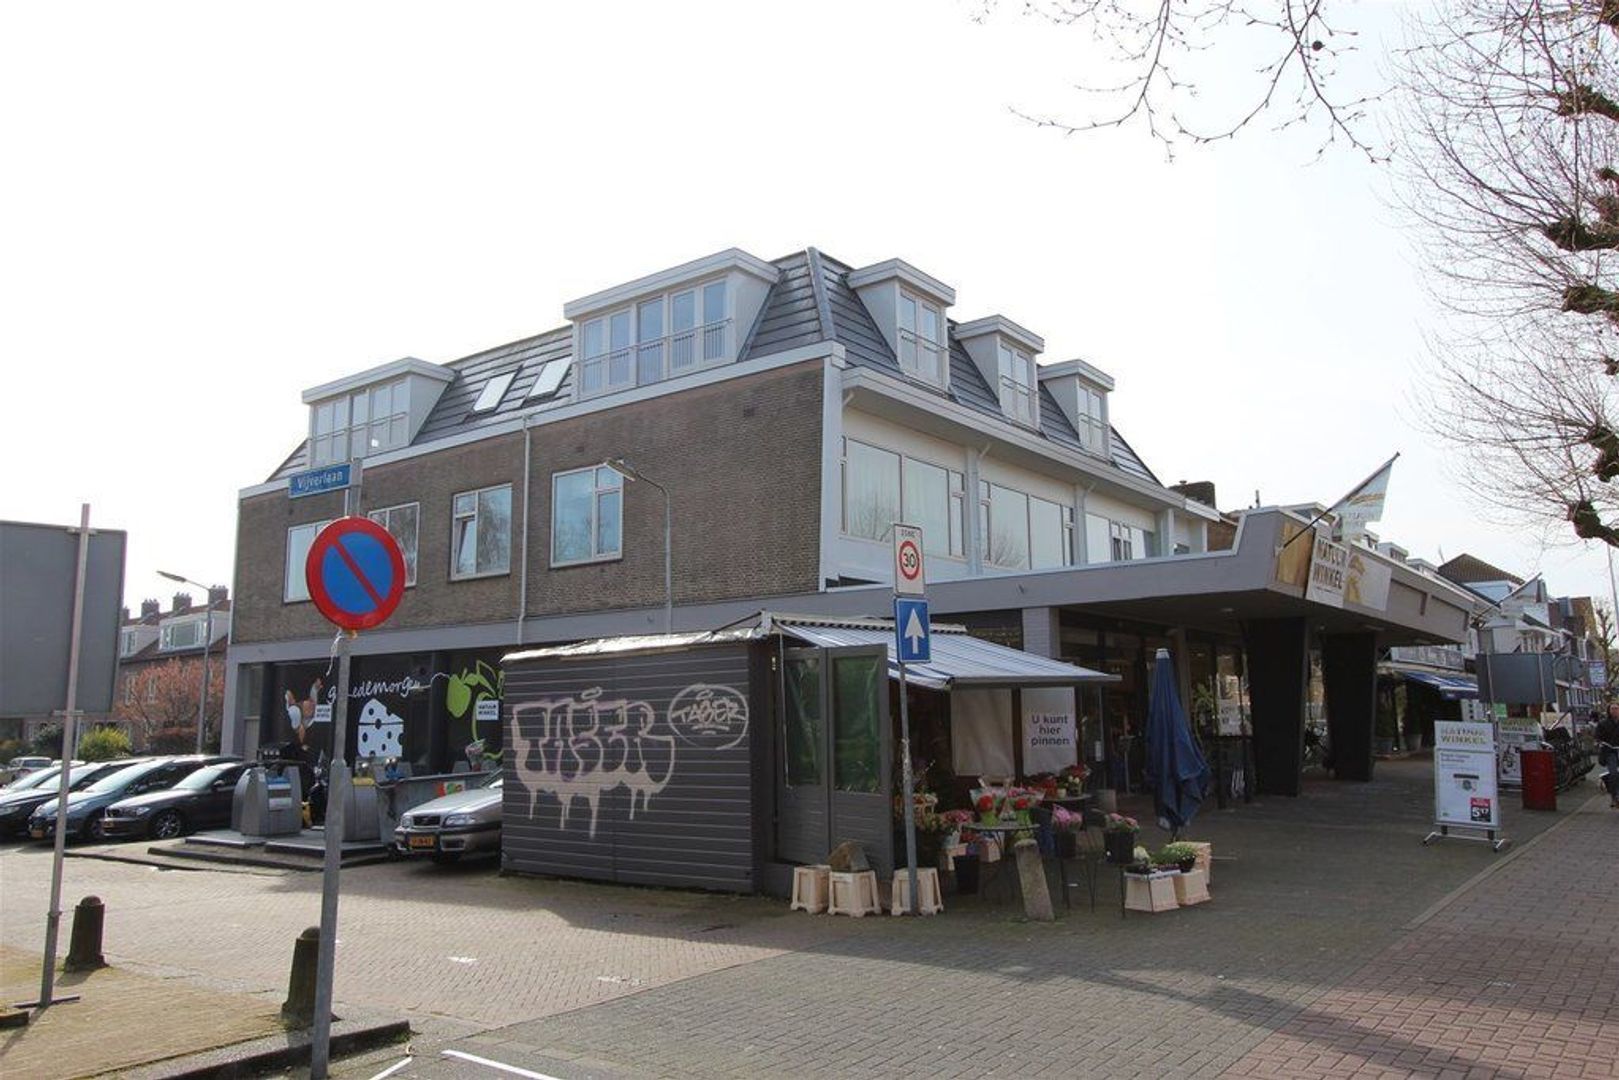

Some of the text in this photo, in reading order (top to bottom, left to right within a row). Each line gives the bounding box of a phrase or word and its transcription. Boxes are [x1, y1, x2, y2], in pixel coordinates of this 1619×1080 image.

[296, 470, 343, 490] Vijverlaan
[903, 553, 917, 568] 30
[1032, 714, 1068, 724] U kunt
[1039, 725, 1061, 735] hier
[1031, 737, 1070, 748] pinnen
[1441, 735, 1487, 744] WINKEL
